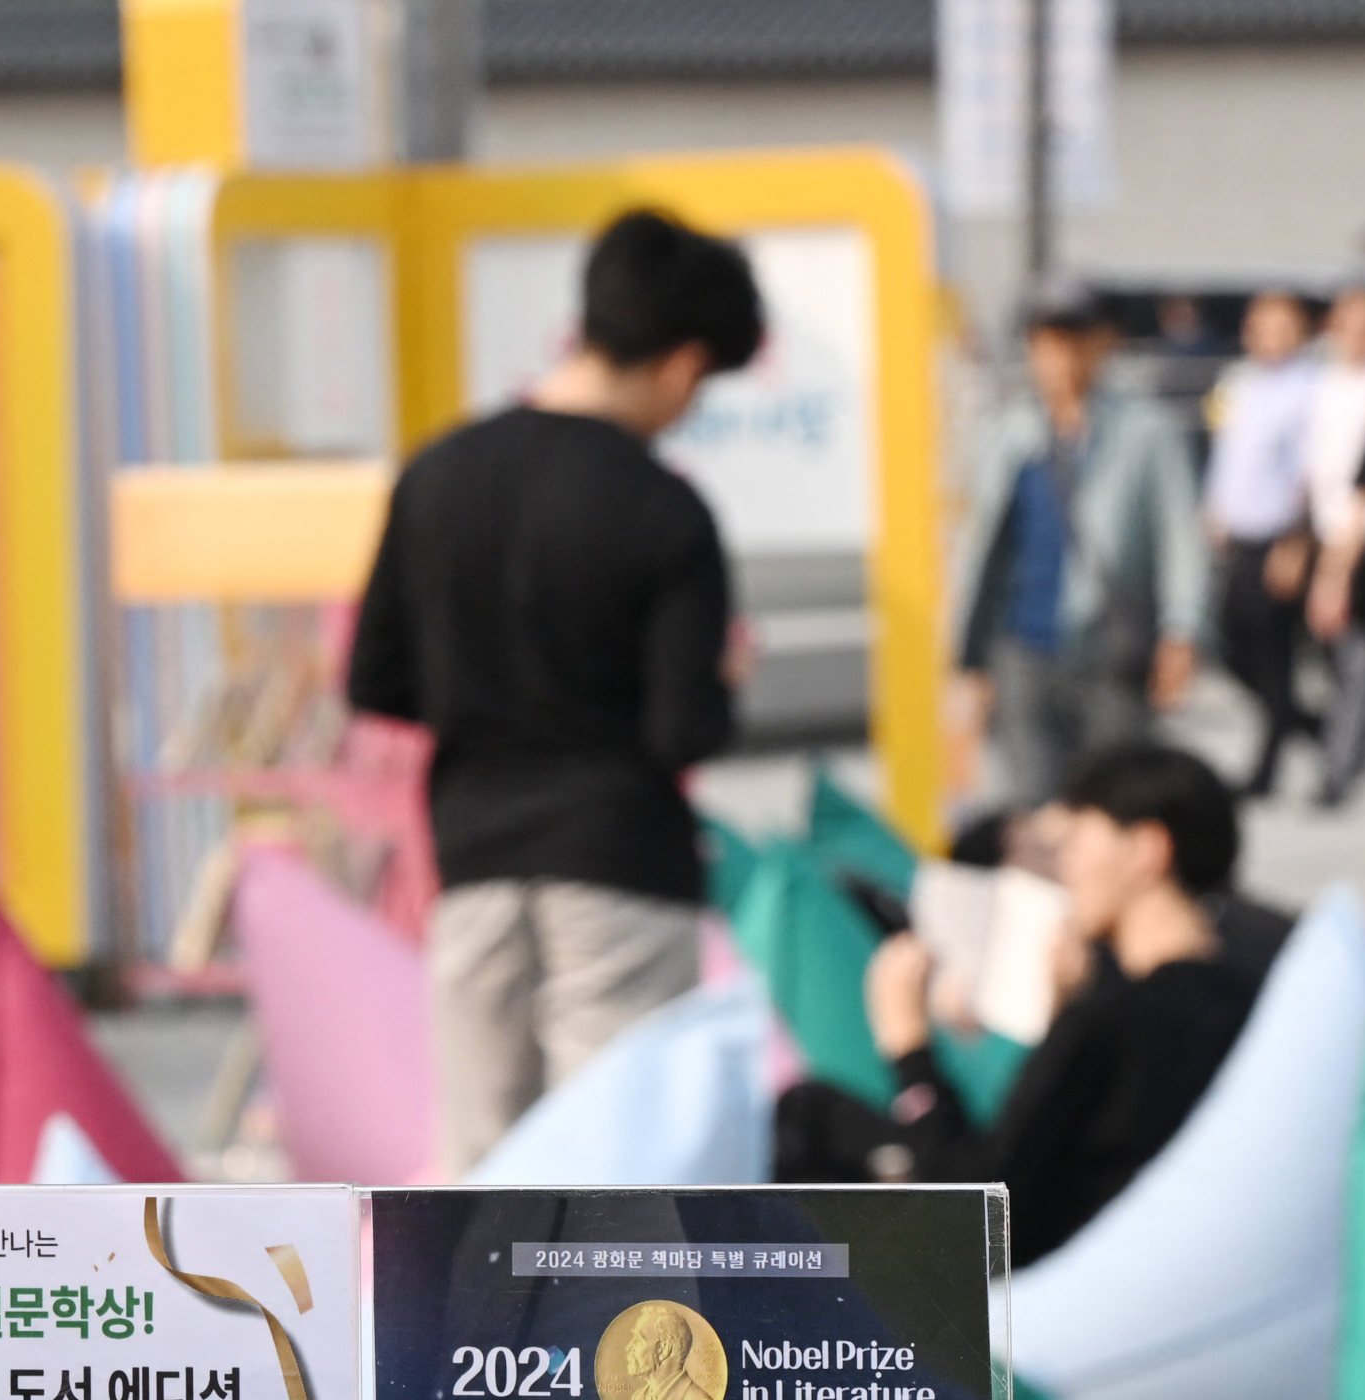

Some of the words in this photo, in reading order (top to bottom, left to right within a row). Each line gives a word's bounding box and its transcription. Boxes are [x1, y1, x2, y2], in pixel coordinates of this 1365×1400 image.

[536, 1250, 585, 1269] 2024
[592, 1250, 644, 1269] 광화문
[651, 1250, 703, 1269] 책마당
[710, 1250, 745, 1269] 특별
[752, 1250, 822, 1270] 큐레이션
[452, 1345, 584, 1398] 2024
[742, 1340, 829, 1371] Nobel
[836, 1341, 914, 1372] Prize
